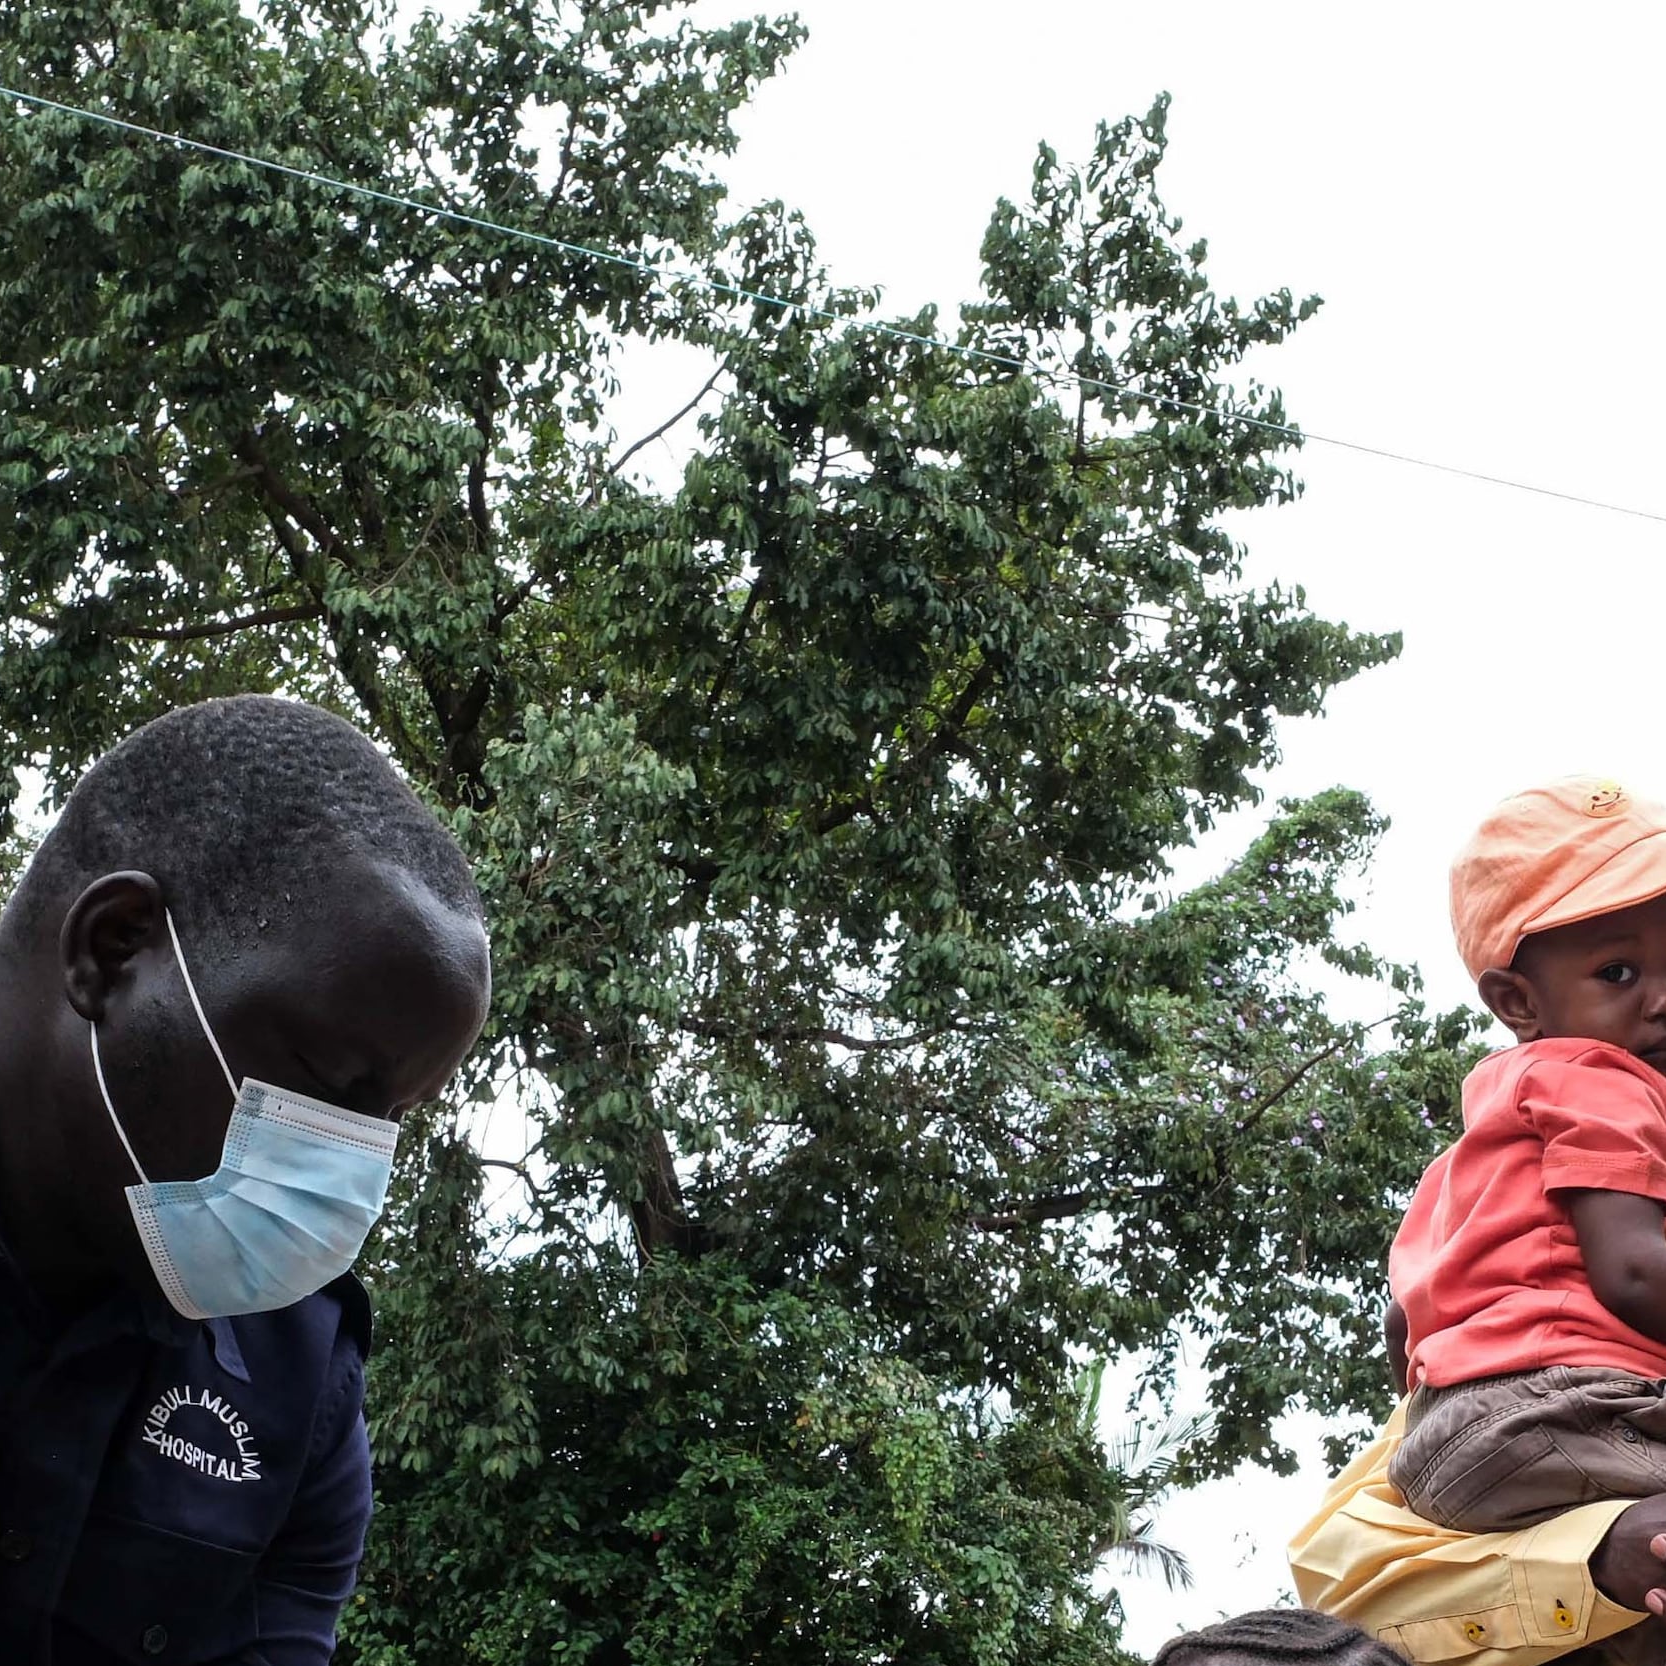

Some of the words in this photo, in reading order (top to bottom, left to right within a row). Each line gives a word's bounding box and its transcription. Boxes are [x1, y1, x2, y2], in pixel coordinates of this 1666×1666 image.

[142, 1385, 192, 1446] KIBULI
[199, 1388, 262, 1482] MUSLIM
[159, 1432, 243, 1483] HOSPITAL
